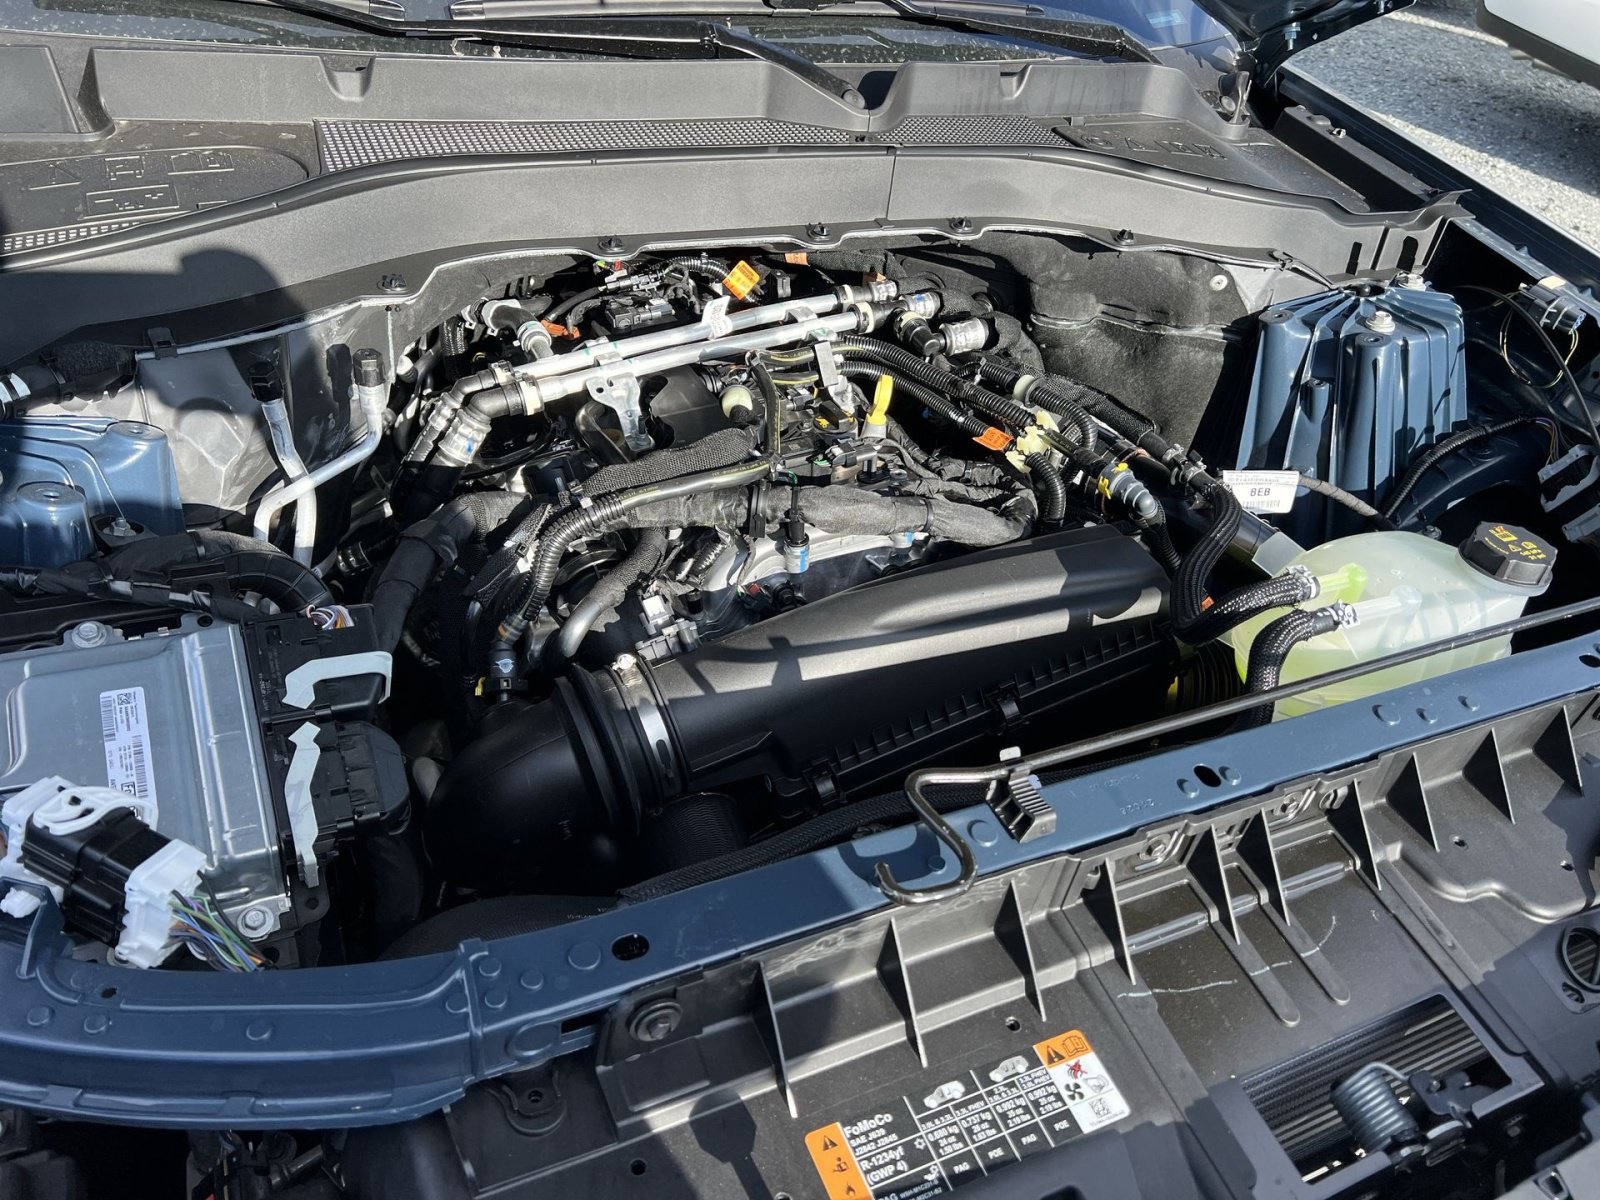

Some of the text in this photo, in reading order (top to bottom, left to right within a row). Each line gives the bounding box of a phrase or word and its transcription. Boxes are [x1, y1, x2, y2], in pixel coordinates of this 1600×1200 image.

[1250, 488, 1271, 496] BEB
[1046, 1084, 1058, 1094] kg
[968, 1100, 985, 1112] PHEV
[995, 1096, 1026, 1114] 0.992 kg
[1052, 1100, 1063, 1109] lbs
[844, 1113, 893, 1138] FoMoCo
[960, 1110, 992, 1128] 0.737 kg
[1006, 1113, 1031, 1128] 2.19 lbs
[986, 1128, 998, 1137] lbs
[1053, 1120, 1070, 1132] POE
[927, 1124, 960, 1142] 0.680 kg
[1020, 1133, 1038, 1146] PAG
[850, 1134, 867, 1147] SAE
[854, 1133, 899, 1156] J2842 J2845
[938, 1135, 957, 1147] 24 oz
[938, 1142, 964, 1156] 1.50 lbs
[988, 1147, 1005, 1160] POE
[860, 1146, 905, 1171] R-1234yf
[866, 1160, 909, 1185] (GWP 4)
[953, 1162, 970, 1174] PAG
